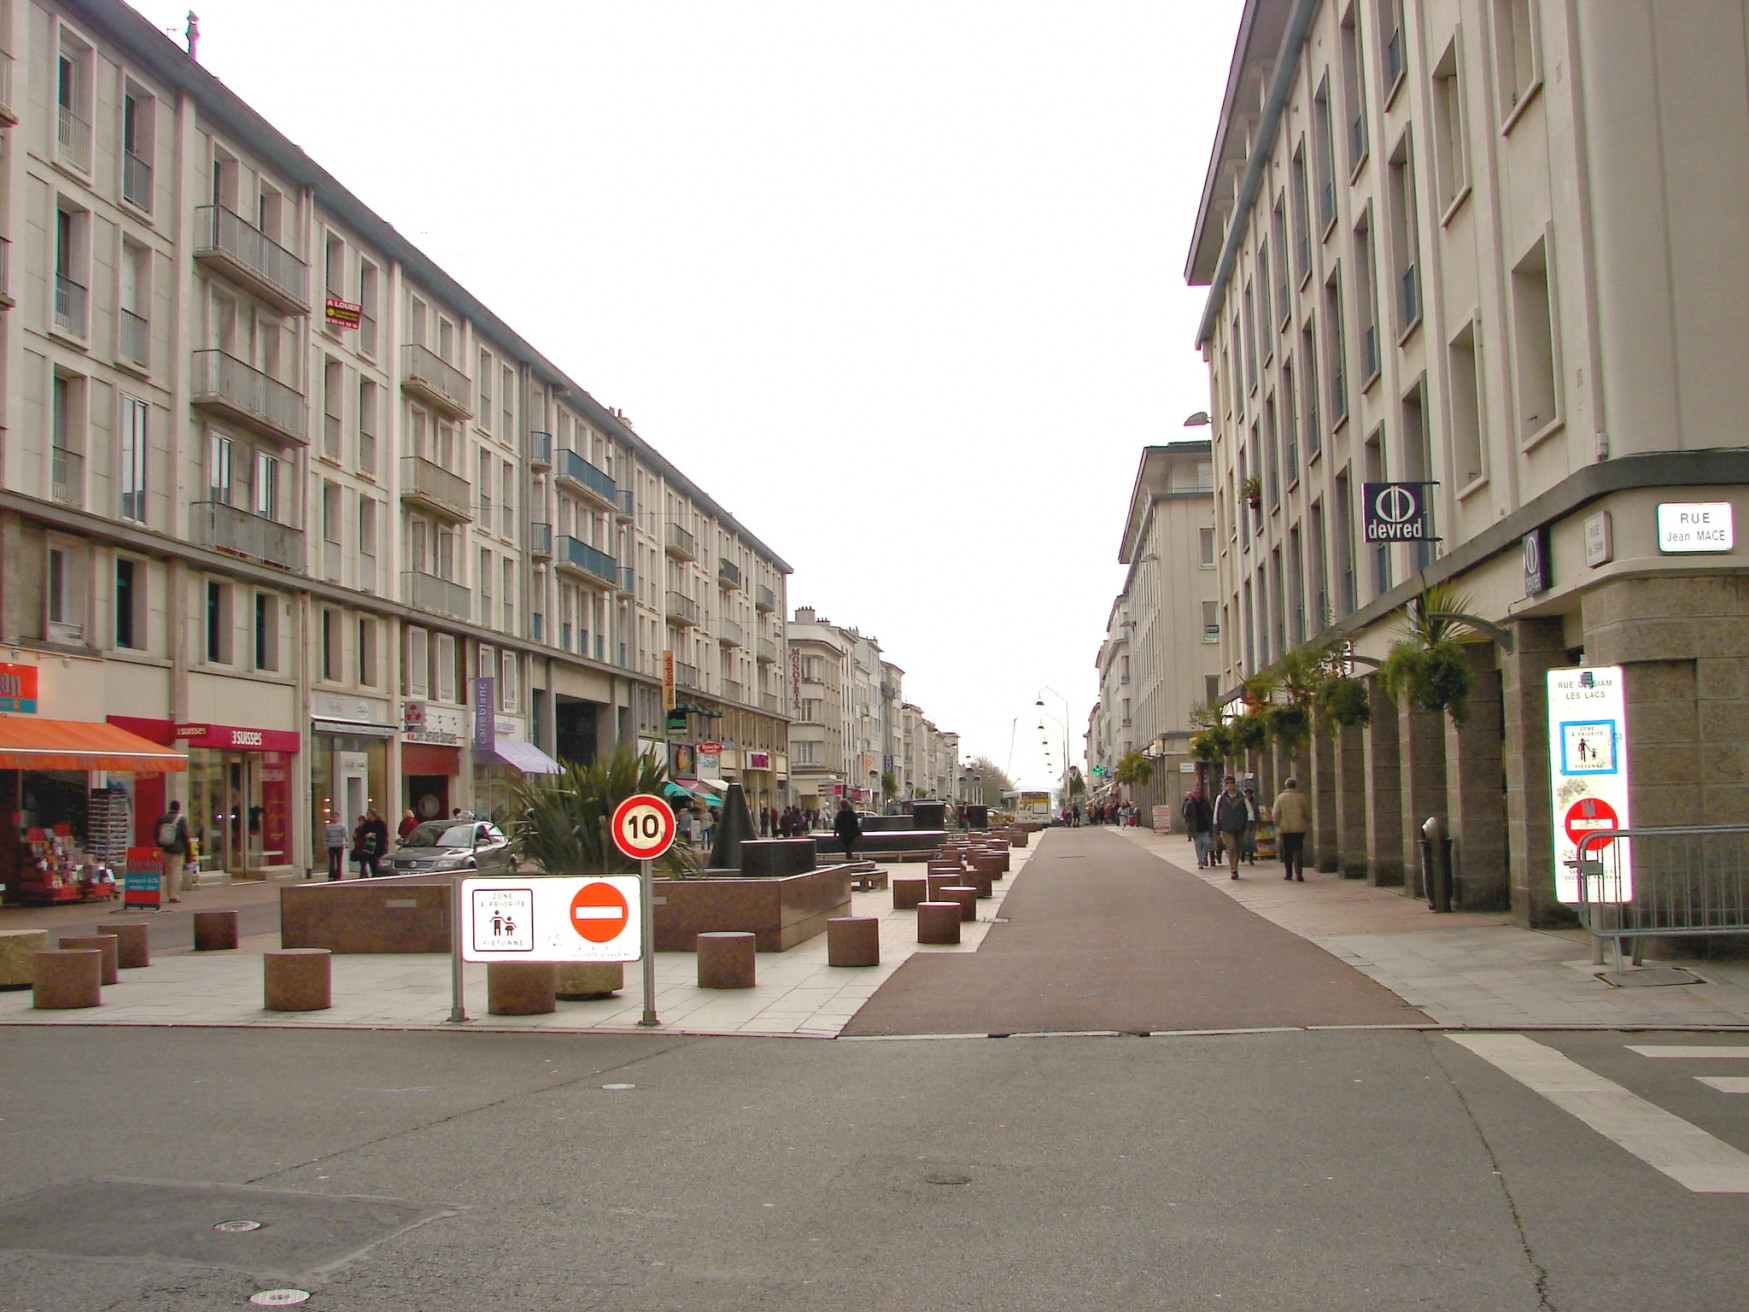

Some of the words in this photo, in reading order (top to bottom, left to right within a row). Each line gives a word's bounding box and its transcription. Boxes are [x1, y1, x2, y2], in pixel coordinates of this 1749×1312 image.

[335, 301, 360, 312] LOUER
[1680, 512, 1711, 524] RUE
[1368, 518, 1422, 539] devred
[1667, 531, 1690, 542] Jean
[1697, 530, 1726, 541] MACE
[665, 655, 674, 686] Kodak
[792, 648, 800, 710] MONOPRIX
[1557, 681, 1574, 689] RUE
[1565, 692, 1581, 700] LES
[1584, 691, 1606, 699] LACS
[628, 814, 660, 839] 10
